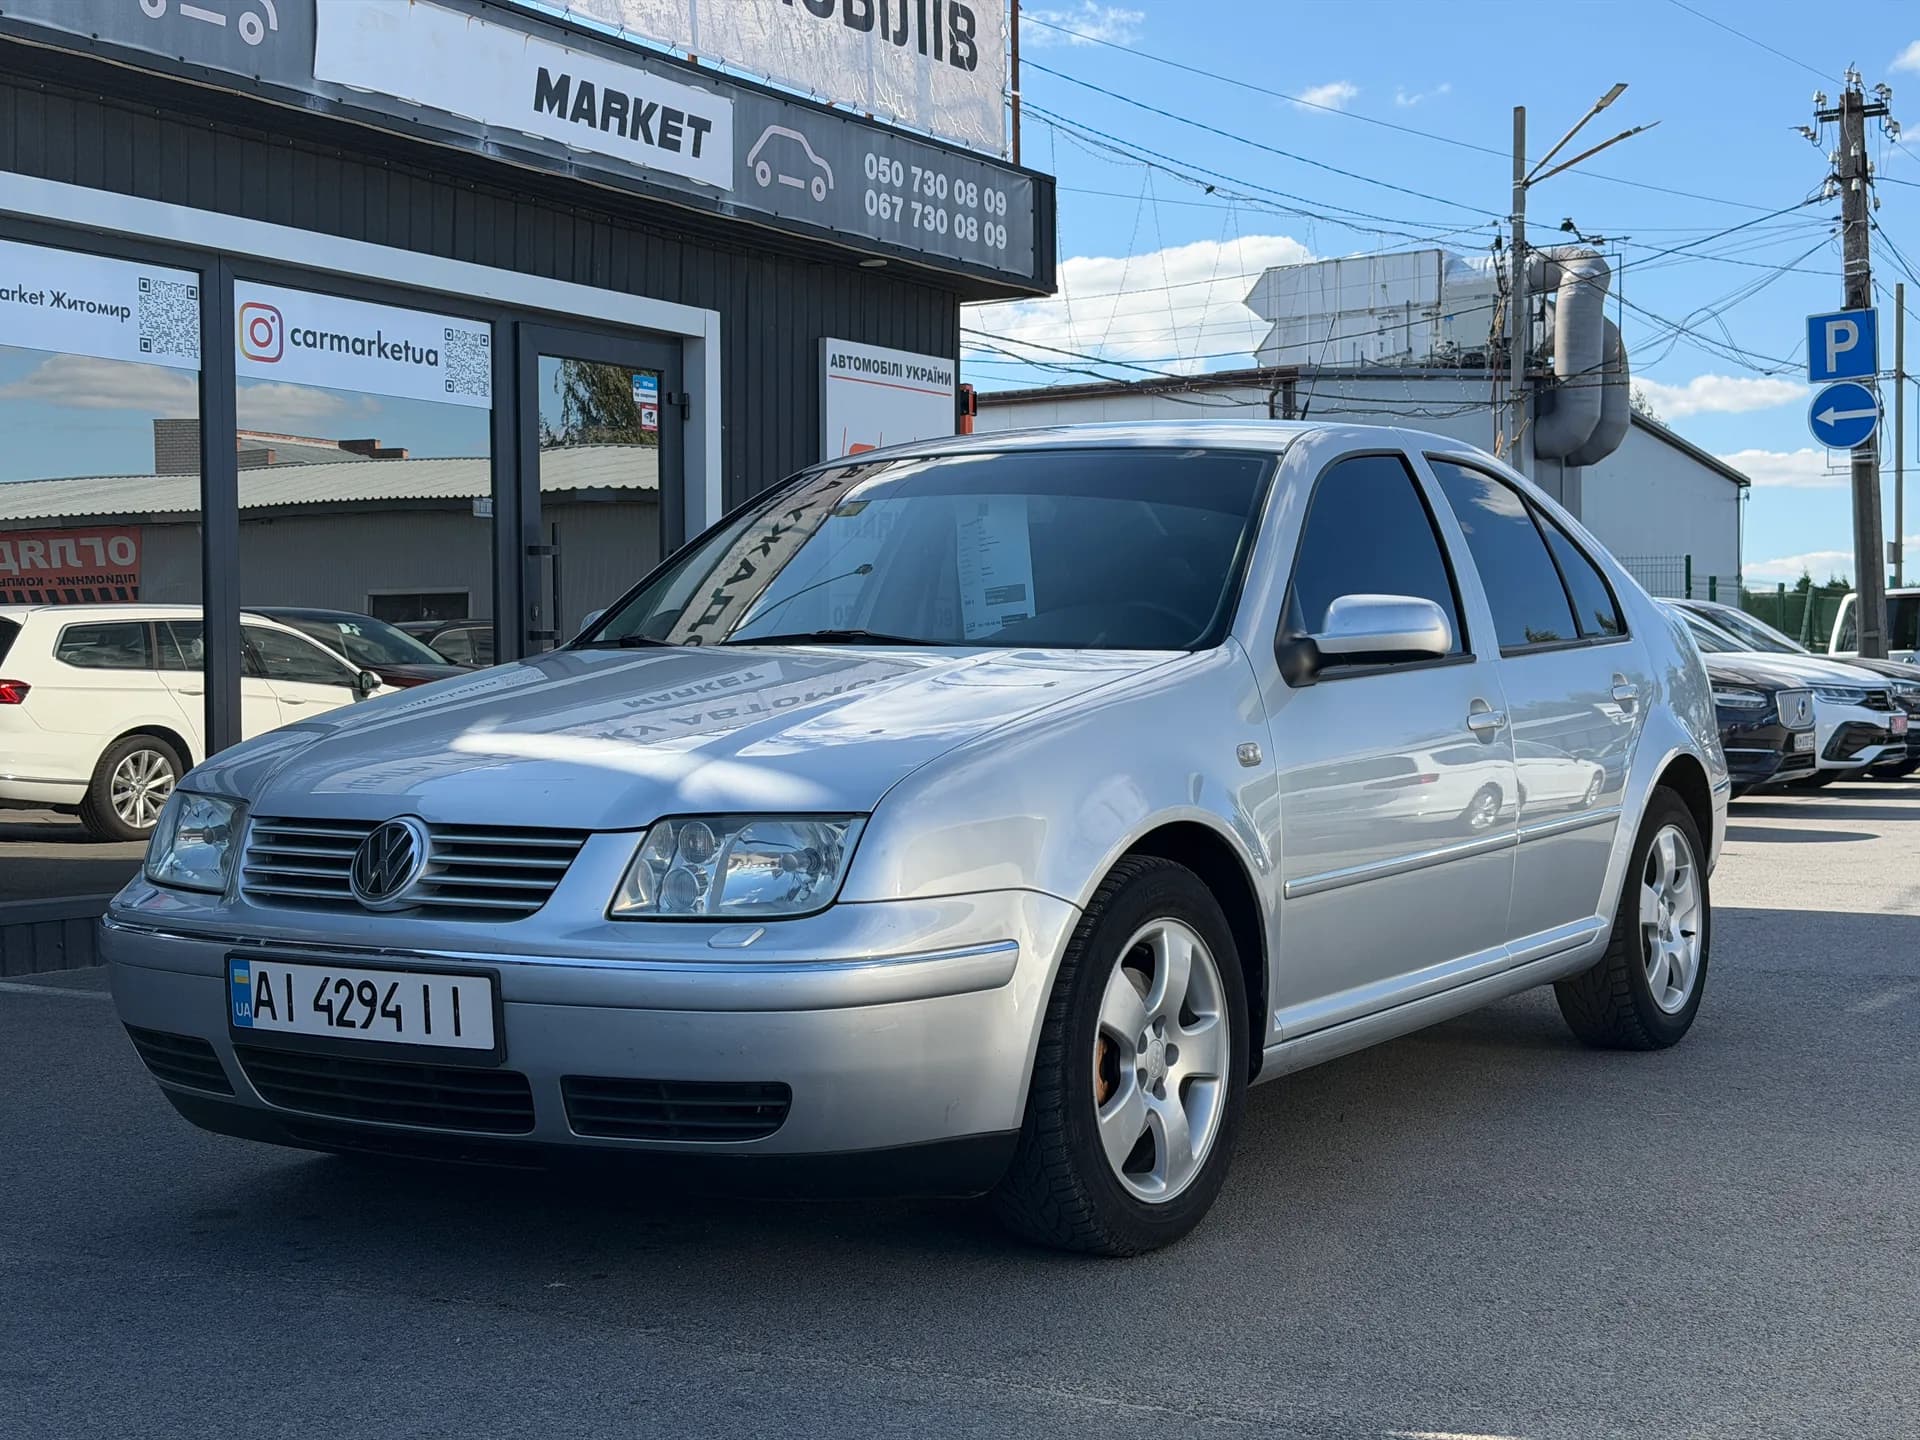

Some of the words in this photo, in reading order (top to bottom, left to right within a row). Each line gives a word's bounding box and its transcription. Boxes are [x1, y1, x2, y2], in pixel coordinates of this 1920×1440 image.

[533, 66, 712, 158] MARKET
[864, 152, 904, 187] 050
[911, 166, 948, 200] 730
[954, 179, 978, 208] 08
[984, 188, 1007, 216] 09
[864, 189, 904, 223] 067
[911, 201, 948, 234] 730
[954, 213, 978, 242] 08
[984, 221, 1007, 249] 09
[49, 290, 131, 323] Житомир
[290, 327, 439, 366] carmarketua
[830, 353, 902, 378] АВТОМОБІЛІ
[905, 364, 952, 386] УКРАЇНИ
[1825, 319, 1859, 373] P
[235, 1002, 251, 1017] UA
[253, 971, 294, 1022] AI
[313, 976, 402, 1032] 4294
